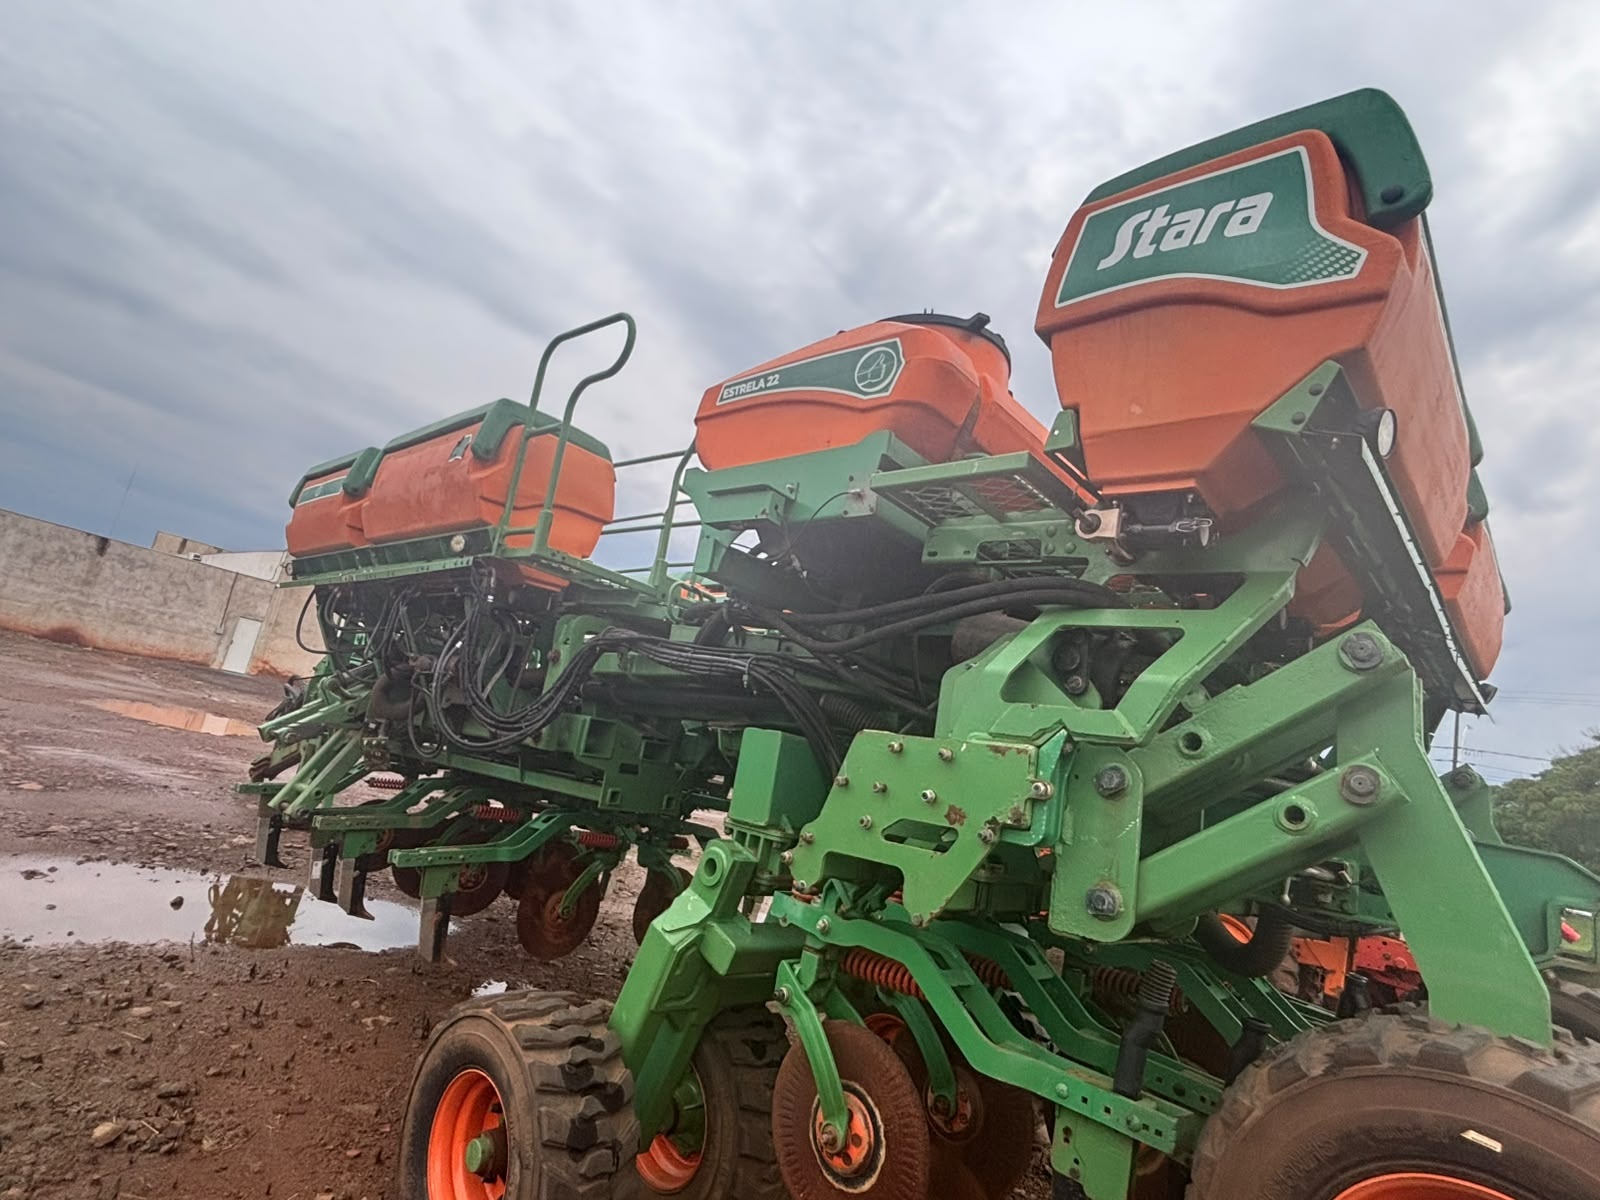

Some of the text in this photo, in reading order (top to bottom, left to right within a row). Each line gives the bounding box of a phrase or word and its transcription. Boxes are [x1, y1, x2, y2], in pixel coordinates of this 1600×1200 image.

[1096, 192, 1274, 271] Stara
[722, 374, 780, 400] ESTRELA 22
